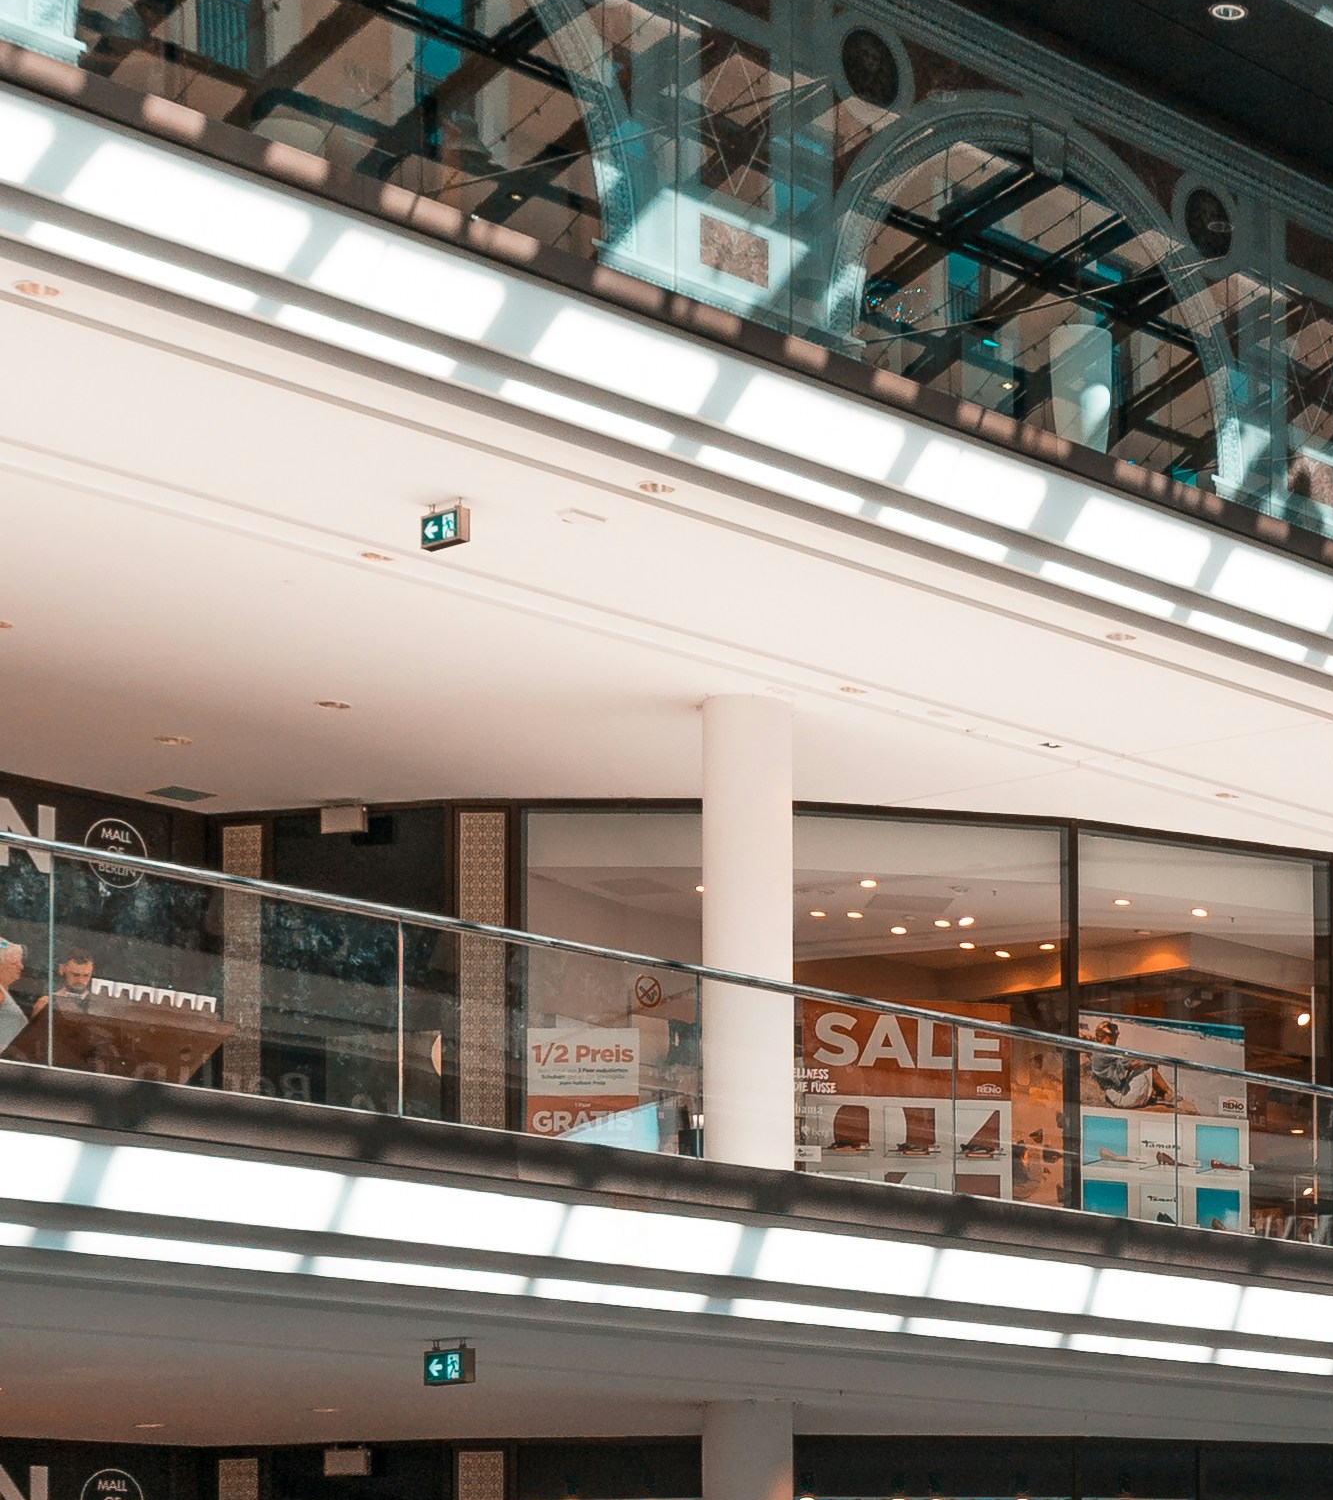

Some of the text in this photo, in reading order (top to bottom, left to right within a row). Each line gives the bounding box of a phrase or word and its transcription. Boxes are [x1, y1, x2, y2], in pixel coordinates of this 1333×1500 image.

[100, 827, 131, 844] MALL
[813, 1011, 1003, 1072] SALE
[532, 1043, 634, 1066] 1/2 Preis
[793, 1068, 829, 1080] ELLNESS
[977, 1083, 1002, 1096] RENO
[1222, 1099, 1244, 1111] RENO
[532, 1110, 634, 1133] GRATIS
[97, 1479, 128, 1492] MALL
